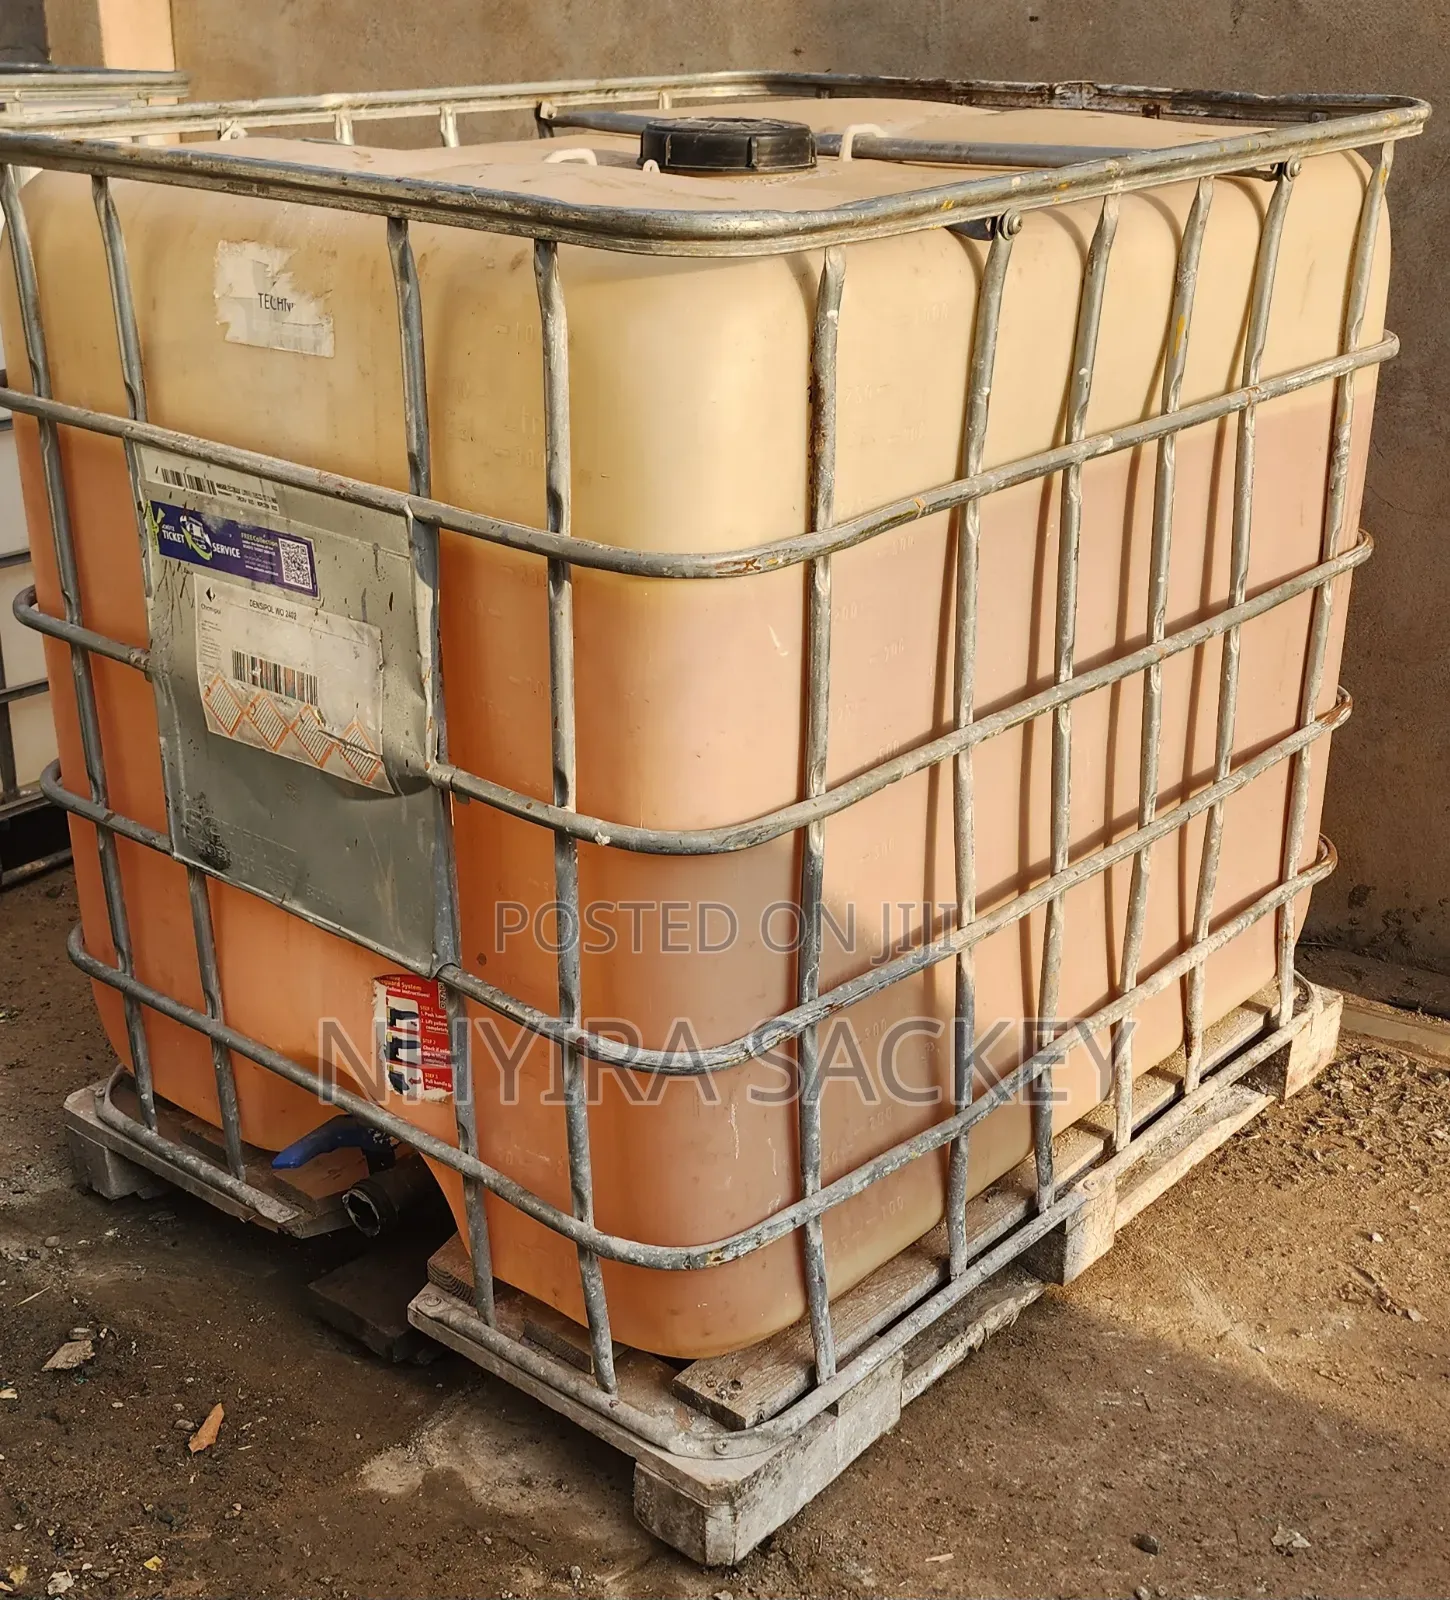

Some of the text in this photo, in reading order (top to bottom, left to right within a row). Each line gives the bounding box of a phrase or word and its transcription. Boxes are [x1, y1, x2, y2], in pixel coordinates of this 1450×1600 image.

[162, 529, 184, 544] TICKET
[212, 542, 241, 559] SERVICE
[401, 982, 422, 990] System
